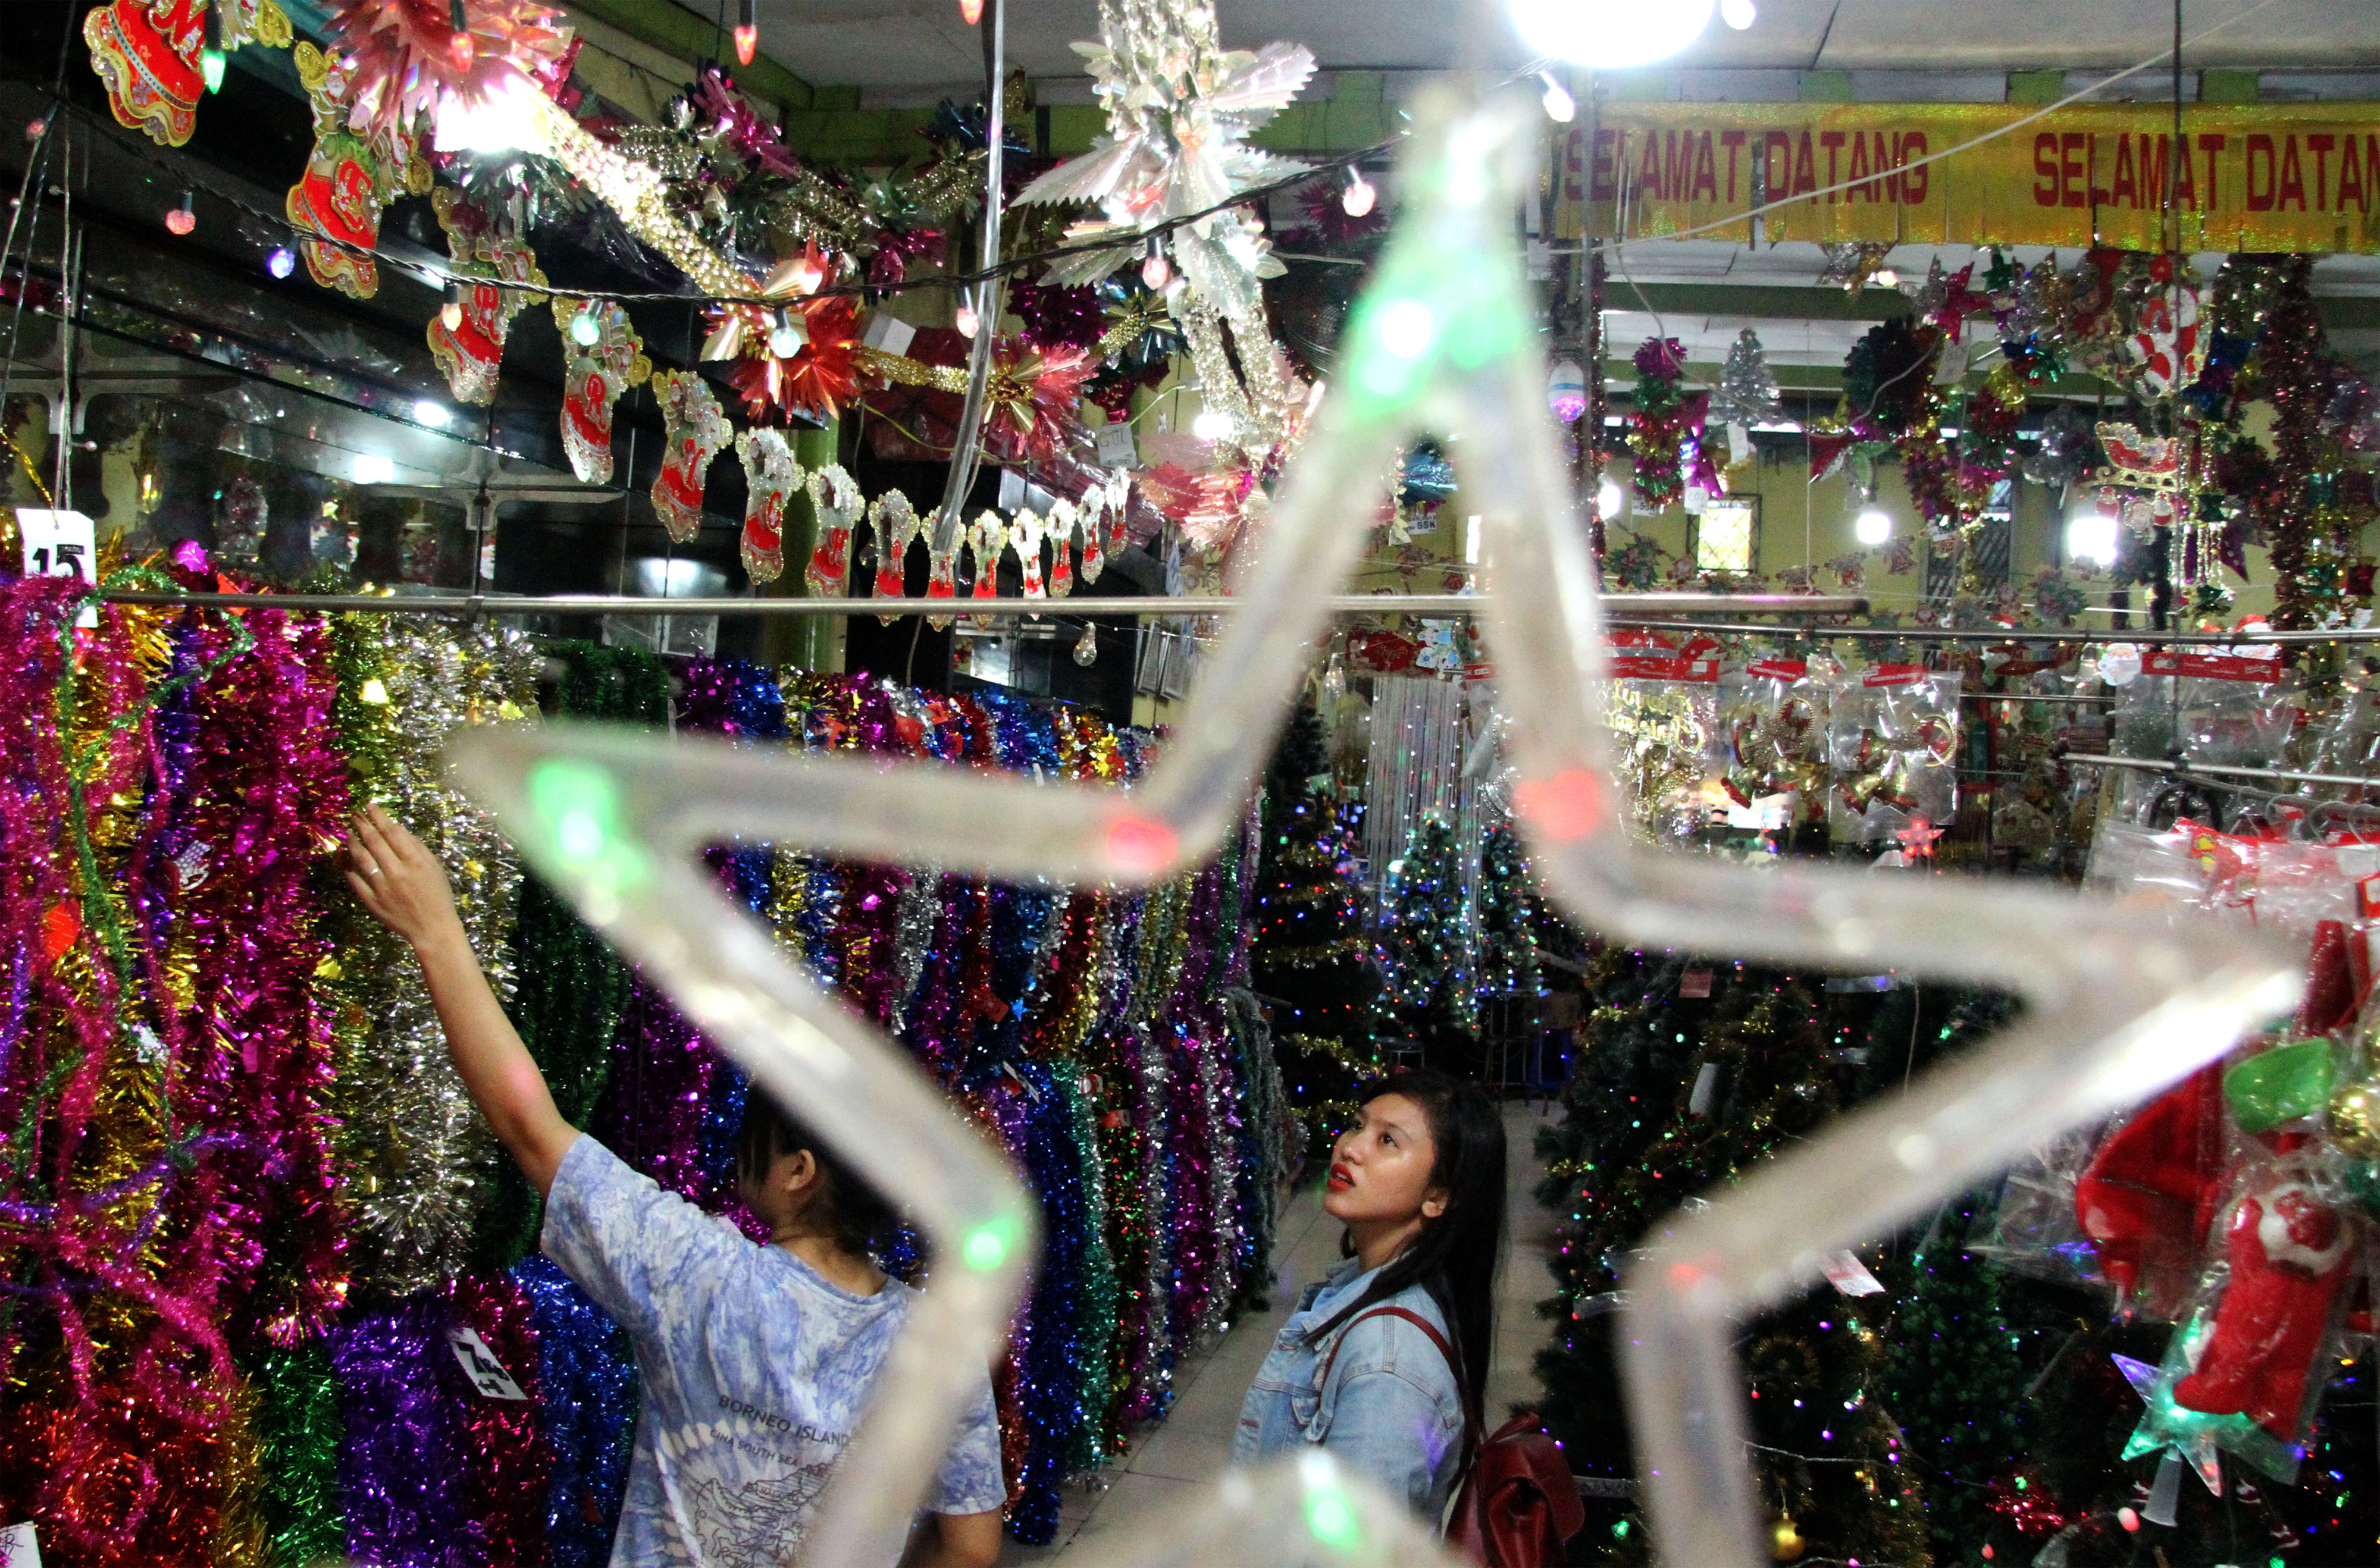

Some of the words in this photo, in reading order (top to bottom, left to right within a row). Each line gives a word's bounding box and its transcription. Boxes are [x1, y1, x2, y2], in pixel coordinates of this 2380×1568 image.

[1564, 128, 1746, 203] SELAMAT
[1764, 131, 1929, 205] DATANG
[2034, 132, 2226, 212] SELAMAT
[32, 544, 85, 579] 15
[718, 1394, 791, 1432] BORNEO
[796, 1425, 851, 1448] ISLAND
[737, 1440, 776, 1460] SOUTH
[778, 1456, 798, 1467] SEA
